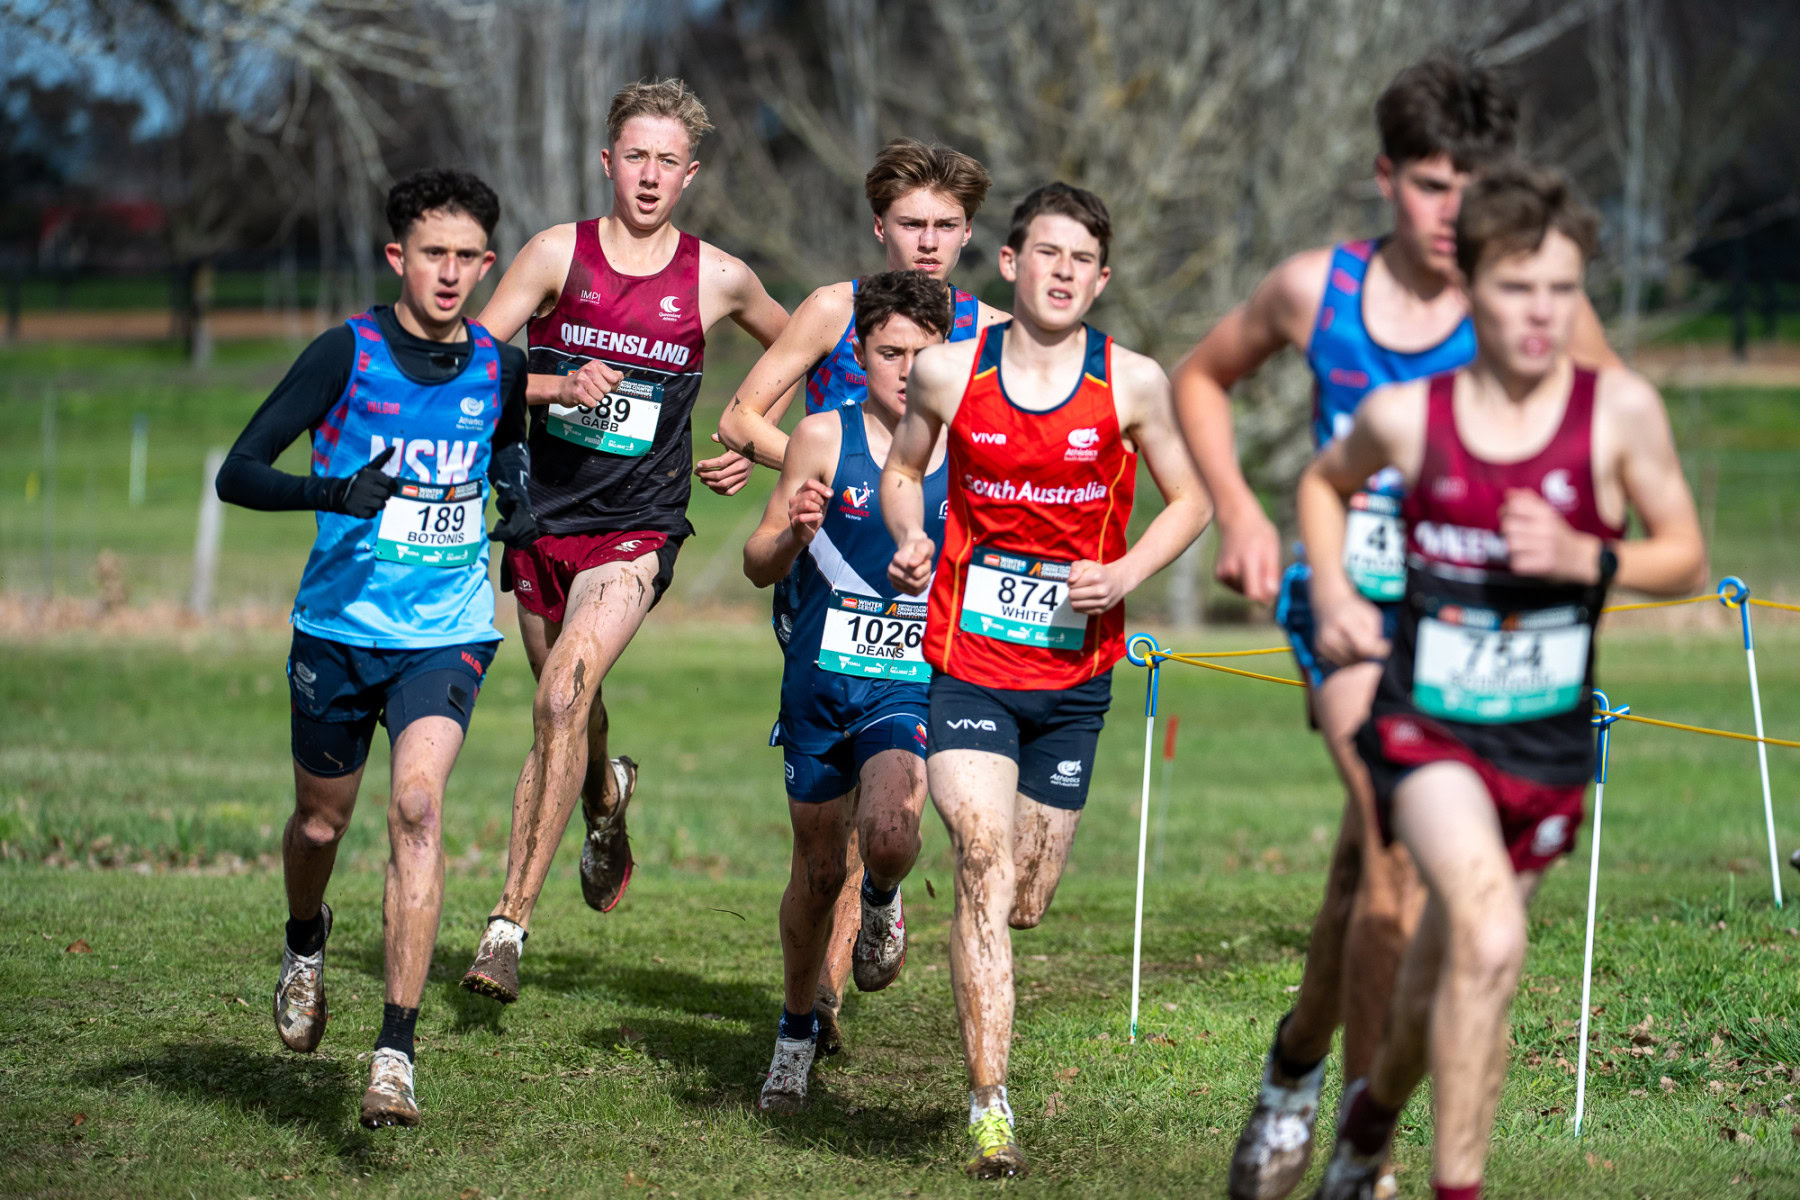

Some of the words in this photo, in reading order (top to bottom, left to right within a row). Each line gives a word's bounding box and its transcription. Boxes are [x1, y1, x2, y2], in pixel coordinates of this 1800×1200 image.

[580, 290, 601, 301] IMPI
[561, 323, 690, 366] QUEENSLAND
[846, 371, 867, 386] VALOU
[367, 400, 400, 415] VALOUR
[581, 415, 619, 432] GABB
[369, 435, 478, 485] NSW
[965, 474, 1016, 501] South
[1016, 480, 1107, 504] Australia
[418, 505, 465, 532] 189
[839, 505, 870, 517] Athletics
[845, 513, 861, 521] Victoria
[407, 531, 464, 544] BOTONIS
[1366, 522, 1387, 551] 4
[998, 577, 1058, 611] 874
[858, 599, 882, 608] WINTER
[1002, 604, 1049, 623] WHITE
[847, 616, 923, 648] 1026
[856, 644, 905, 658] DEANS
[1050, 773, 1080, 783] Athletics
